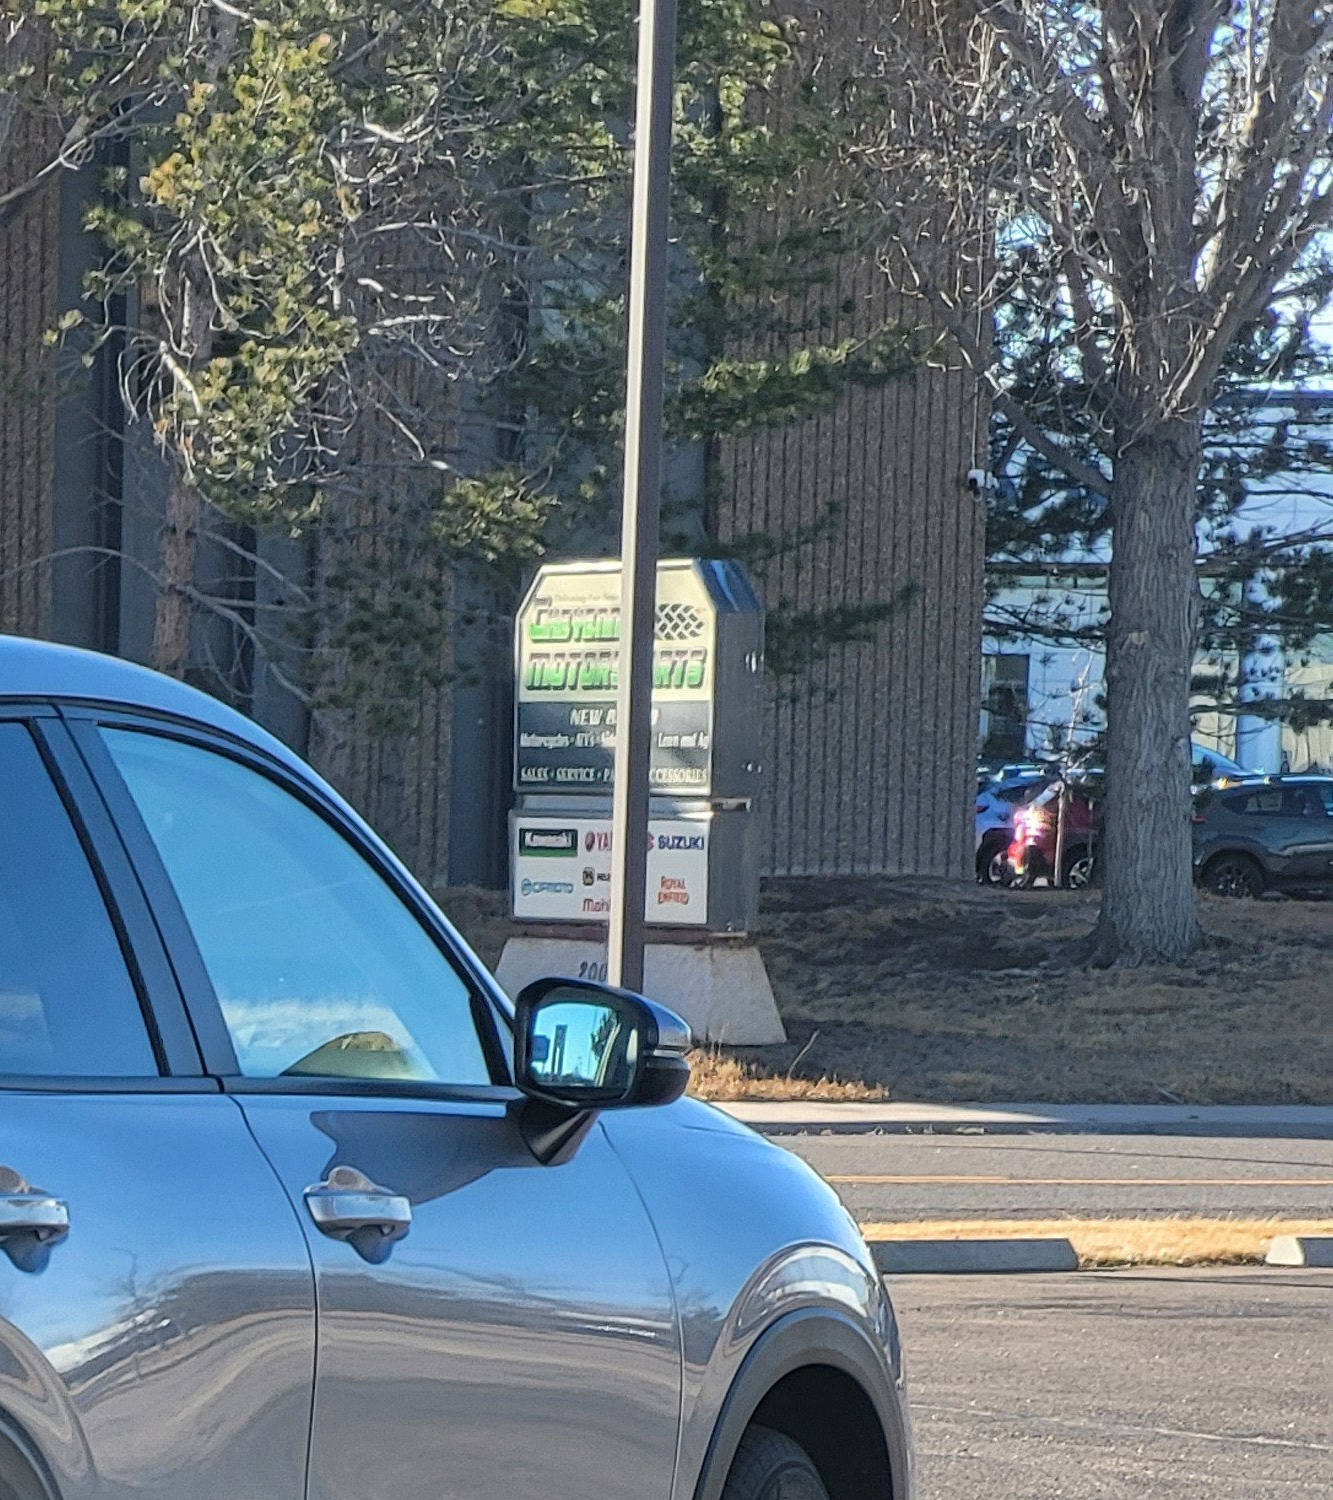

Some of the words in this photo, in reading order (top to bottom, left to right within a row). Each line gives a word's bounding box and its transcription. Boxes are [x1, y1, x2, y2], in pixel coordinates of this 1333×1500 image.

[526, 648, 708, 691] MOTORSRTS
[569, 709, 604, 727] NEW
[520, 766, 549, 782] SALES
[554, 766, 595, 782] SERVICE
[649, 767, 708, 784] CCESSORIES
[658, 835, 704, 850] SUZUKI
